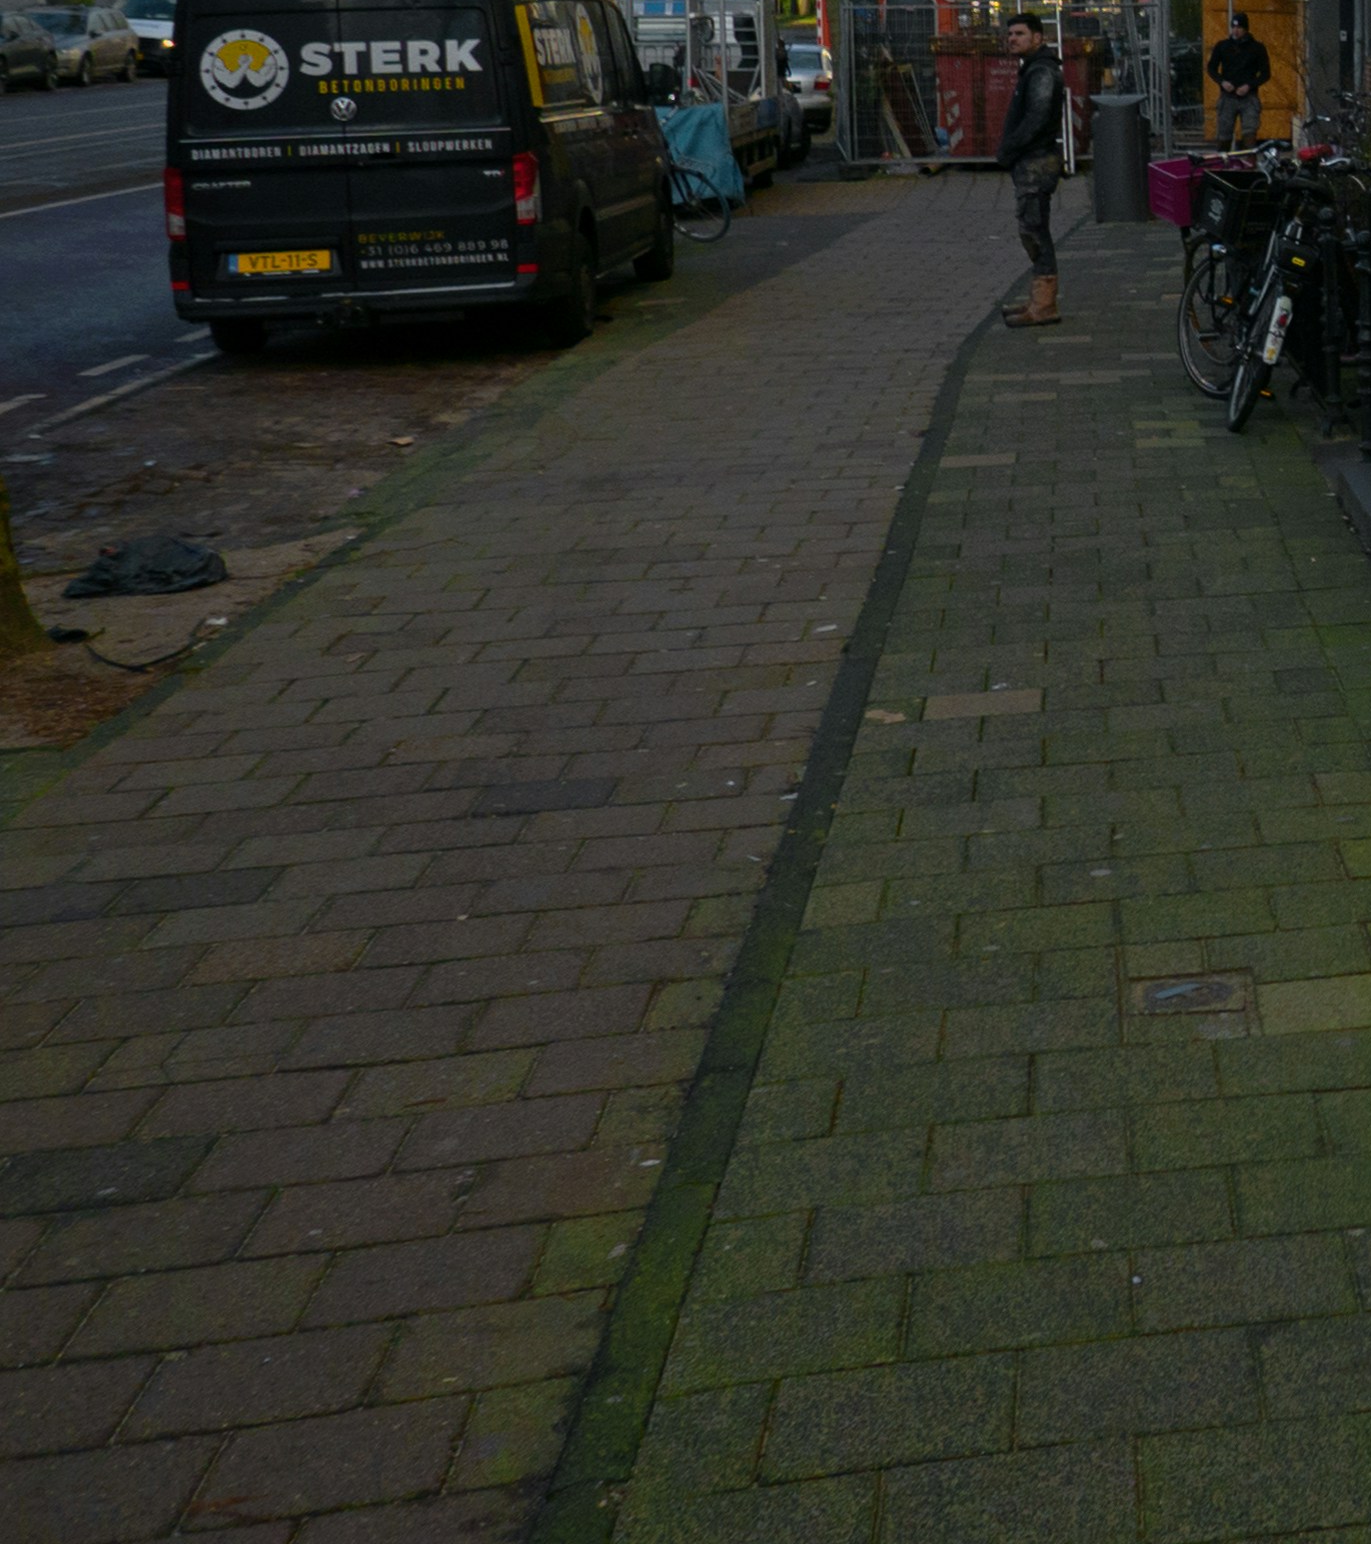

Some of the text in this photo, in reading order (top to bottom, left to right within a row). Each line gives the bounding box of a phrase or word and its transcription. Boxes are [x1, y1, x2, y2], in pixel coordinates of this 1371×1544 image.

[299, 38, 483, 76] STERK
[317, 75, 465, 95] BETONBORINGEN
[191, 138, 493, 160] DIAMANTBOREN DIAMANTZAGEN SLOOPWERKEN
